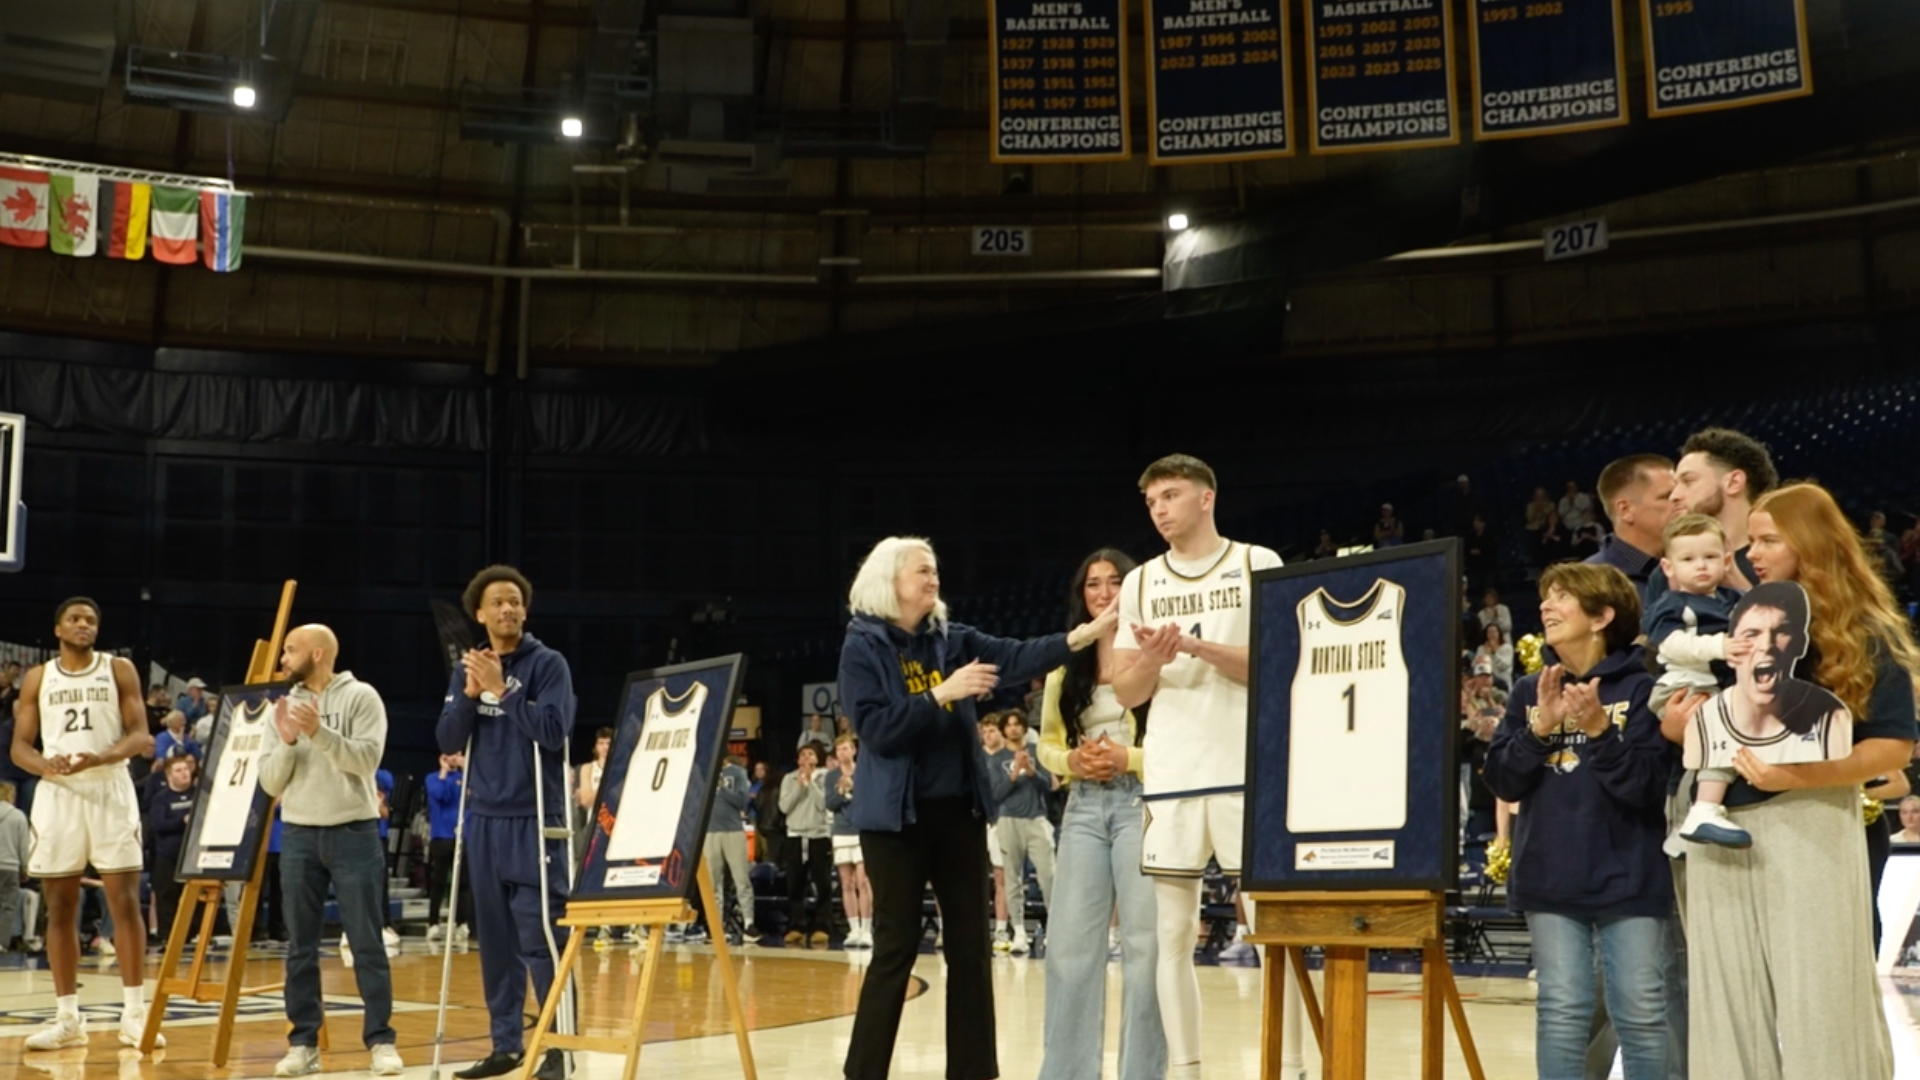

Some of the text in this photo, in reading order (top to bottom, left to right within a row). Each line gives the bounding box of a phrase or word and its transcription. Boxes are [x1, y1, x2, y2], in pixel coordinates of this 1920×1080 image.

[1032, 3, 1083, 16] MEN'S
[1190, 0, 1243, 13] MEN'S
[1322, 0, 1433, 18] BASKETBALL
[1483, 1, 1563, 22] 1993 2002
[1656, 0, 1694, 17] 1995
[1005, 17, 1110, 31] BASKETBALL
[1162, 9, 1271, 30] BASKETBALL
[1319, 15, 1440, 38] 1993 2002 2003
[1002, 37, 1116, 50] 1927 1928 1929
[1160, 29, 1278, 50] 1987 1996 2002
[1319, 37, 1441, 58] 2016 2017 2020
[1002, 57, 1116, 70] 1937 1938 1940
[1160, 49, 1279, 70] 2022 2023 2024
[1321, 57, 1442, 79] 2022 2023 2025
[1657, 48, 1797, 83] CONFERENCE
[1002, 76, 1116, 90] 1950 1951 1952
[1483, 79, 1615, 107] CONFERENCE
[1659, 67, 1799, 102] CHAMPIONS
[1002, 97, 1035, 110] 1964
[1043, 97, 1076, 110] 1967
[1320, 99, 1446, 122] CONFERENCE
[1484, 97, 1617, 125] CHAMPIONS
[1000, 115, 1120, 131] CONFERENCE
[1159, 110, 1282, 132] CONFERENCE
[1320, 116, 1447, 140] CHAMPIONS
[1000, 132, 1121, 149] CHAMPIONS
[1159, 128, 1284, 150] CHAMPIONS
[981, 230, 1023, 252] 205
[1553, 222, 1598, 254] 207
[1151, 586, 1241, 619] MONTANA STATE
[1311, 639, 1385, 675] MONTANA STATE
[49, 686, 109, 706] MONTANA STATE
[1342, 683, 1355, 732] 1
[65, 707, 94, 732] 21
[229, 757, 249, 786] 21
